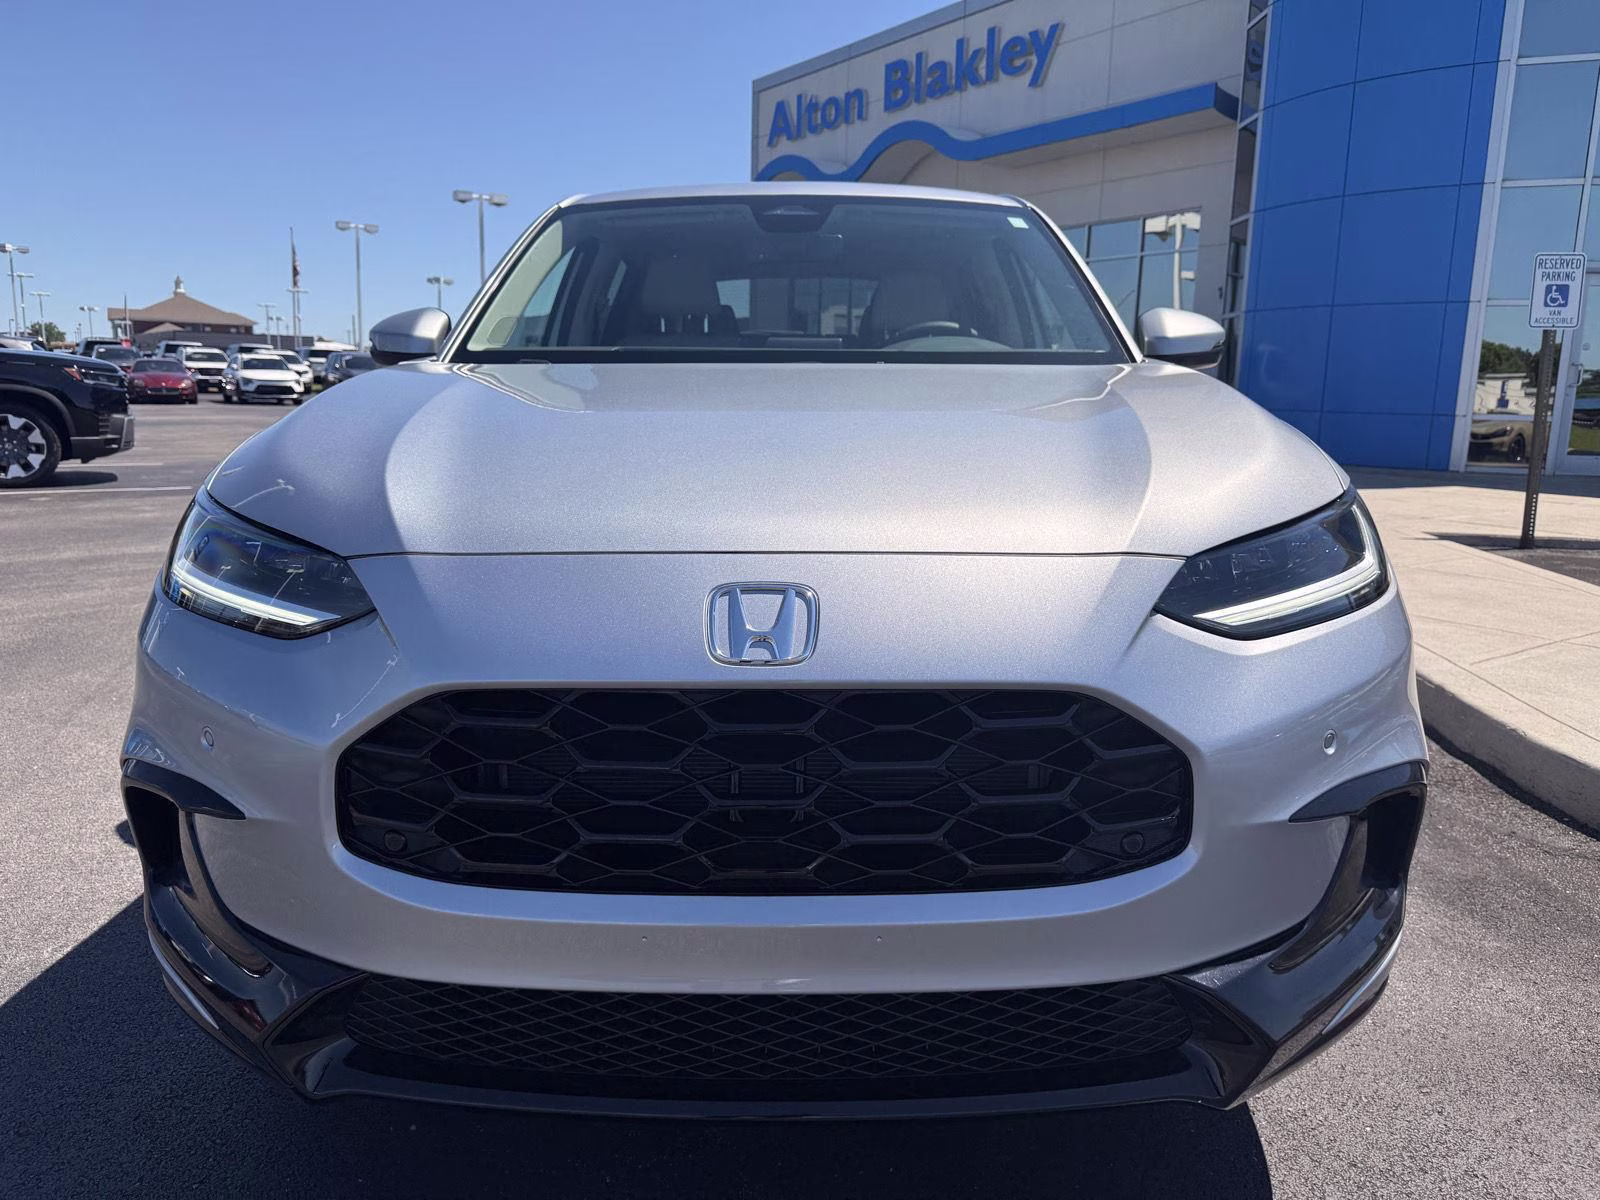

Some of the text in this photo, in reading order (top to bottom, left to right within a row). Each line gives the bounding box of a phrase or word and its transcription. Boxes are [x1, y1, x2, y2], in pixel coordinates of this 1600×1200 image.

[767, 22, 1063, 147] Alton Blakley
[1538, 258, 1581, 269] RESERVED
[1541, 271, 1576, 282] PARKING
[1534, 317, 1575, 325] ACCESSIBLE
